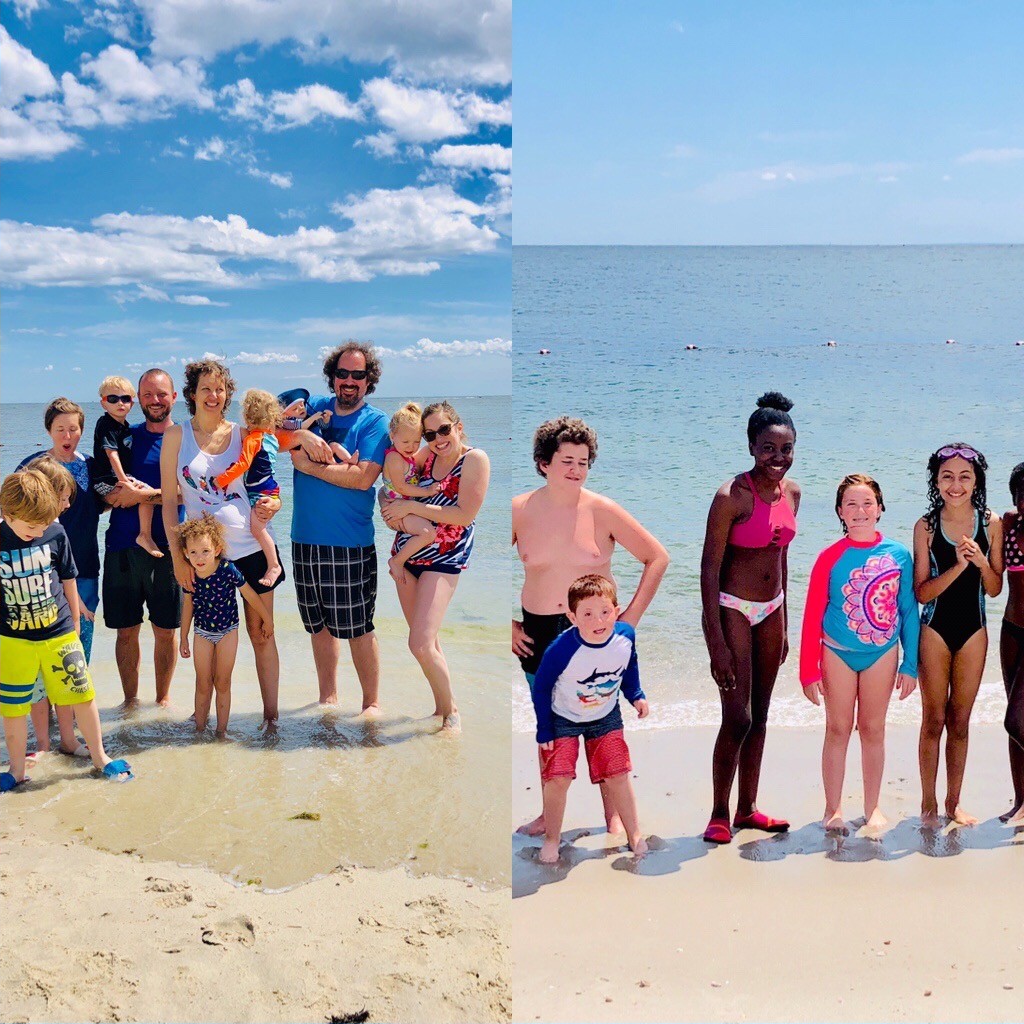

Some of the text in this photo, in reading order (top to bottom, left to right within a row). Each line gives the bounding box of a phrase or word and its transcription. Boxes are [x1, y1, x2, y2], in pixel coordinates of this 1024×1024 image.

[0, 544, 52, 579] SUN
[1, 570, 53, 606] SURF
[6, 597, 59, 630] SAND
